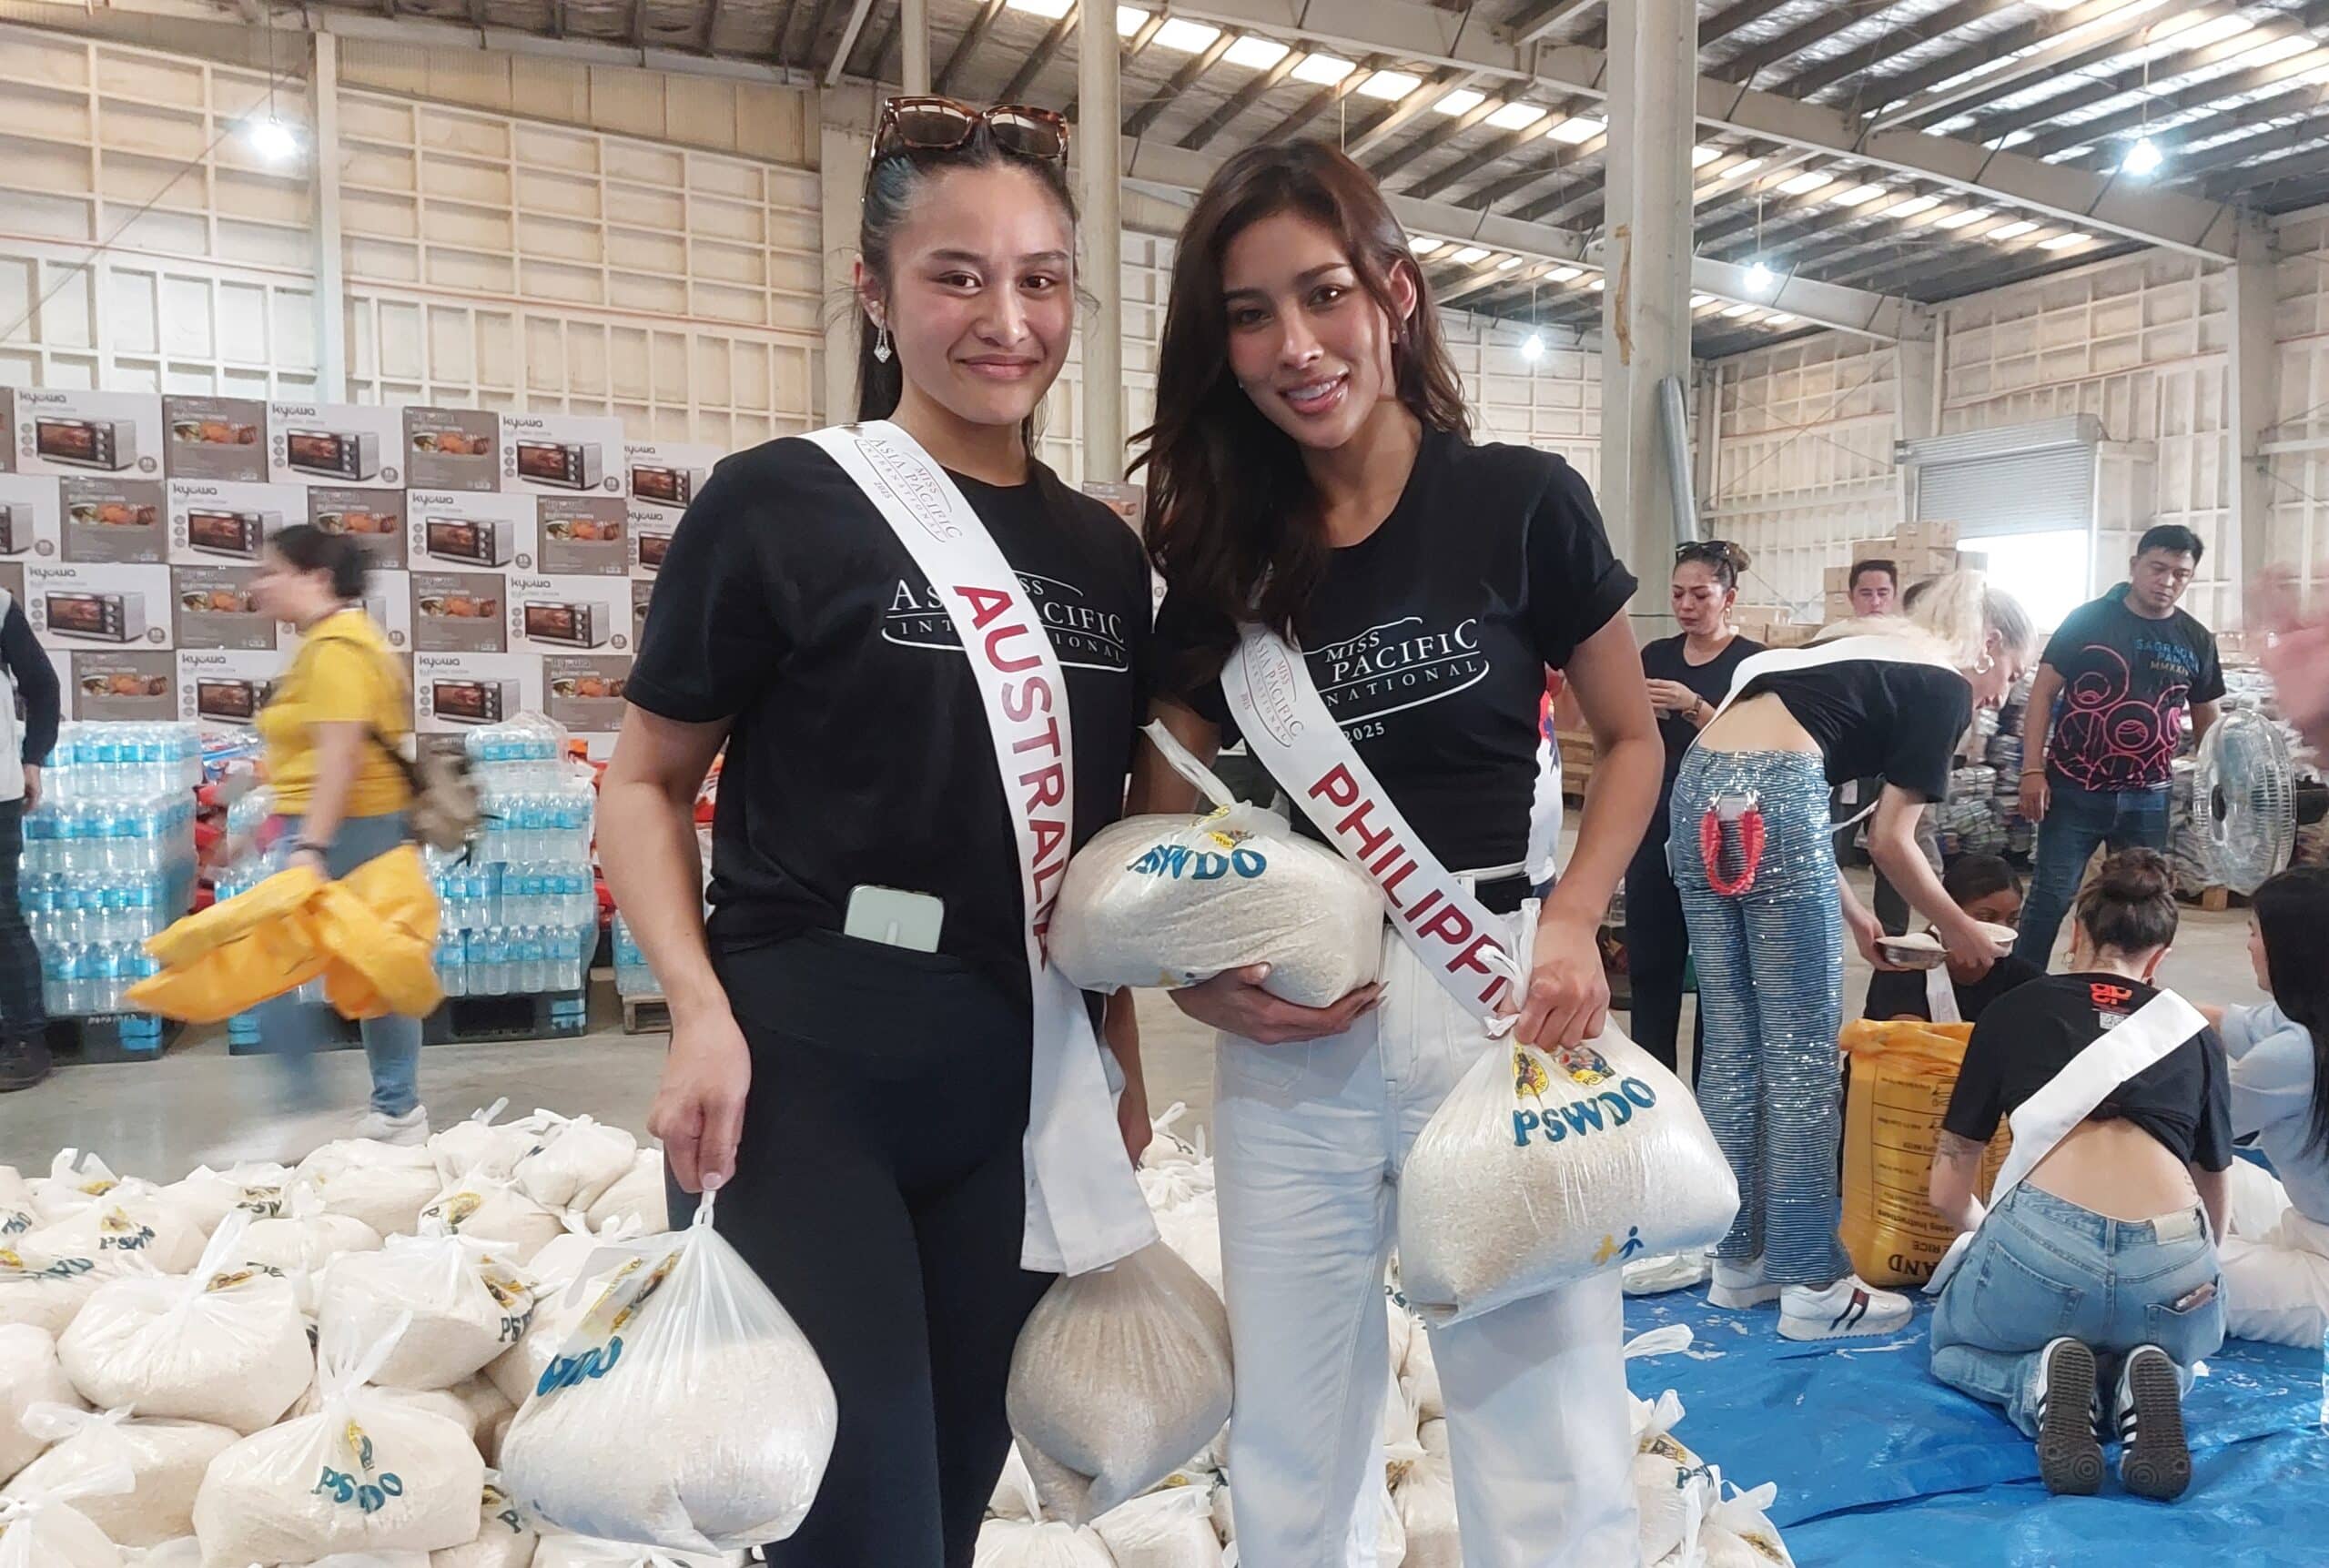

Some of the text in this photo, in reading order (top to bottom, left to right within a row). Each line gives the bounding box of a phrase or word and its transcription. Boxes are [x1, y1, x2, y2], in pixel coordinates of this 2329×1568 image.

[20, 391, 66, 403] kyowa
[272, 403, 316, 417] kyowa
[503, 417, 543, 429] kyowa
[173, 483, 218, 496] kyowa
[412, 492, 454, 505] kyowa
[29, 566, 76, 579] kyowa
[511, 577, 552, 590] kyowa
[1325, 632, 1381, 663] MISS
[1332, 619, 1479, 683] PACIFIC
[182, 653, 227, 666] kyowa
[419, 655, 461, 668] kyowa
[1326, 660, 1478, 707] NATIONAL
[1343, 722, 1385, 743] 2025
[1308, 763, 1509, 1004] PHILIPPI
[1513, 1077, 1657, 1147] PSWDO
